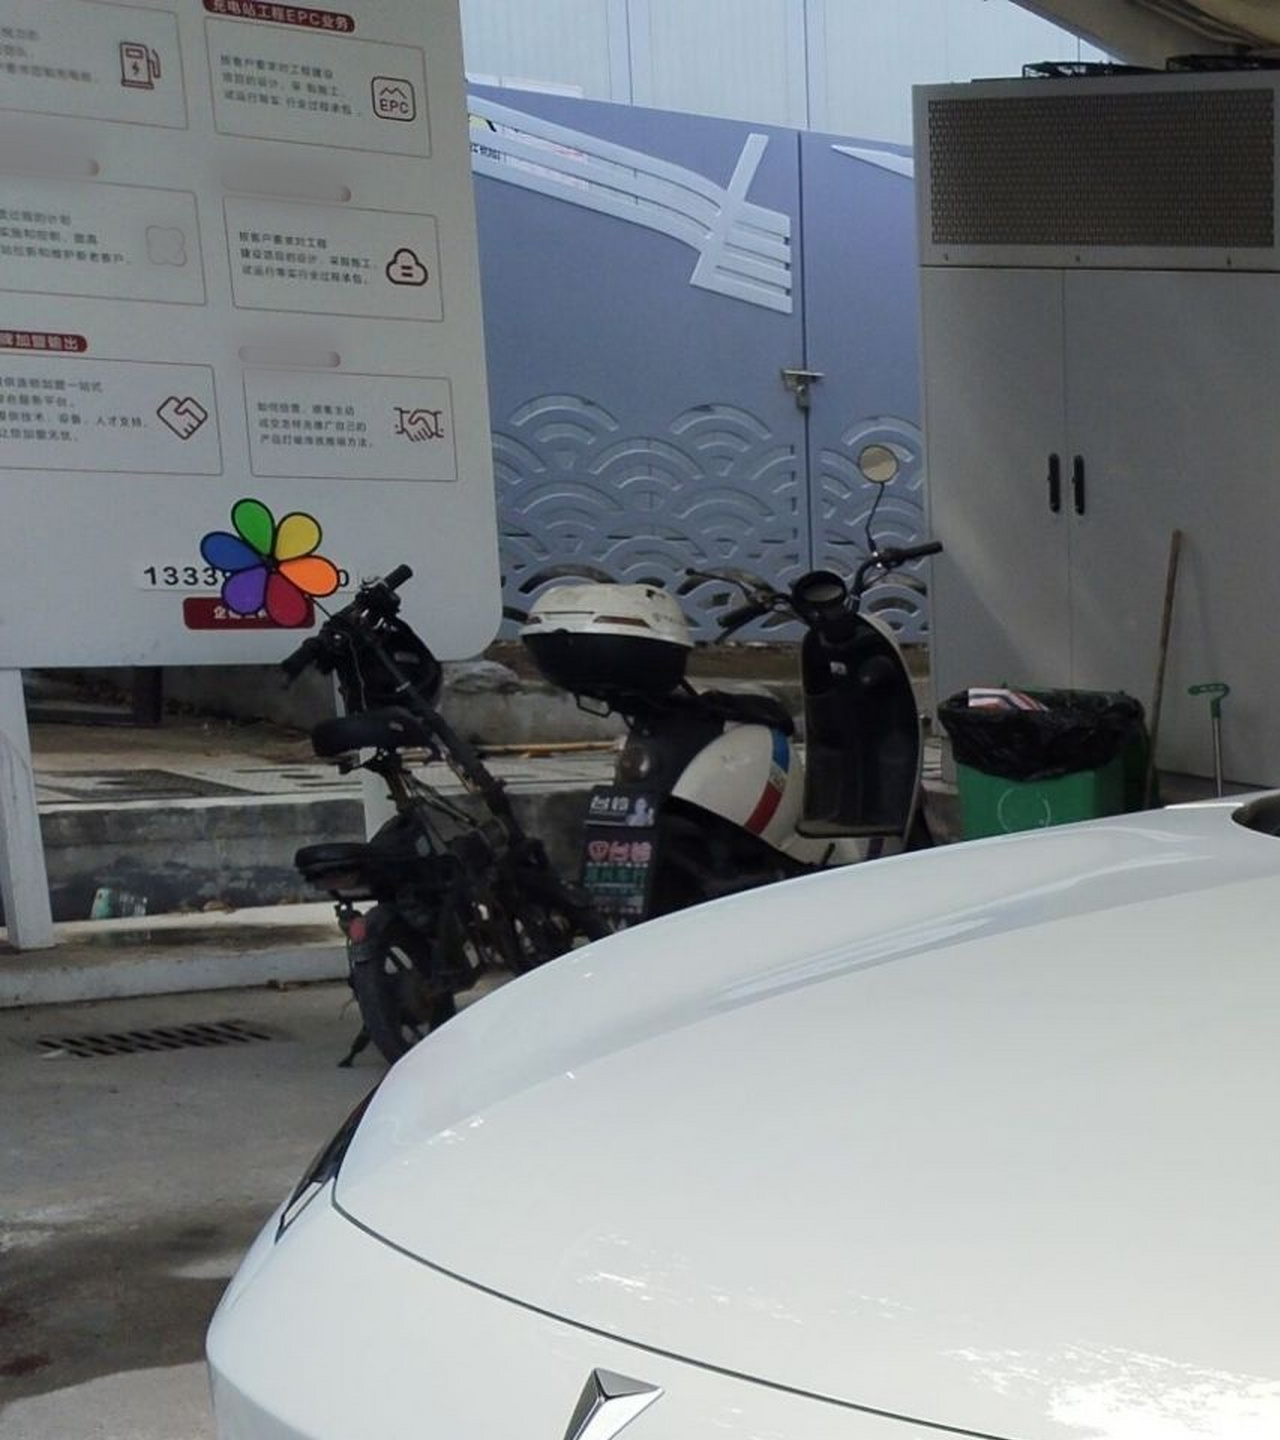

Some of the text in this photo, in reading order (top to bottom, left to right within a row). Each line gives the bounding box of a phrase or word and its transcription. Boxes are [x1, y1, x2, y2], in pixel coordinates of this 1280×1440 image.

[213, 0, 349, 30] 充电站工程EPC业务
[379, 98, 409, 114] EPC
